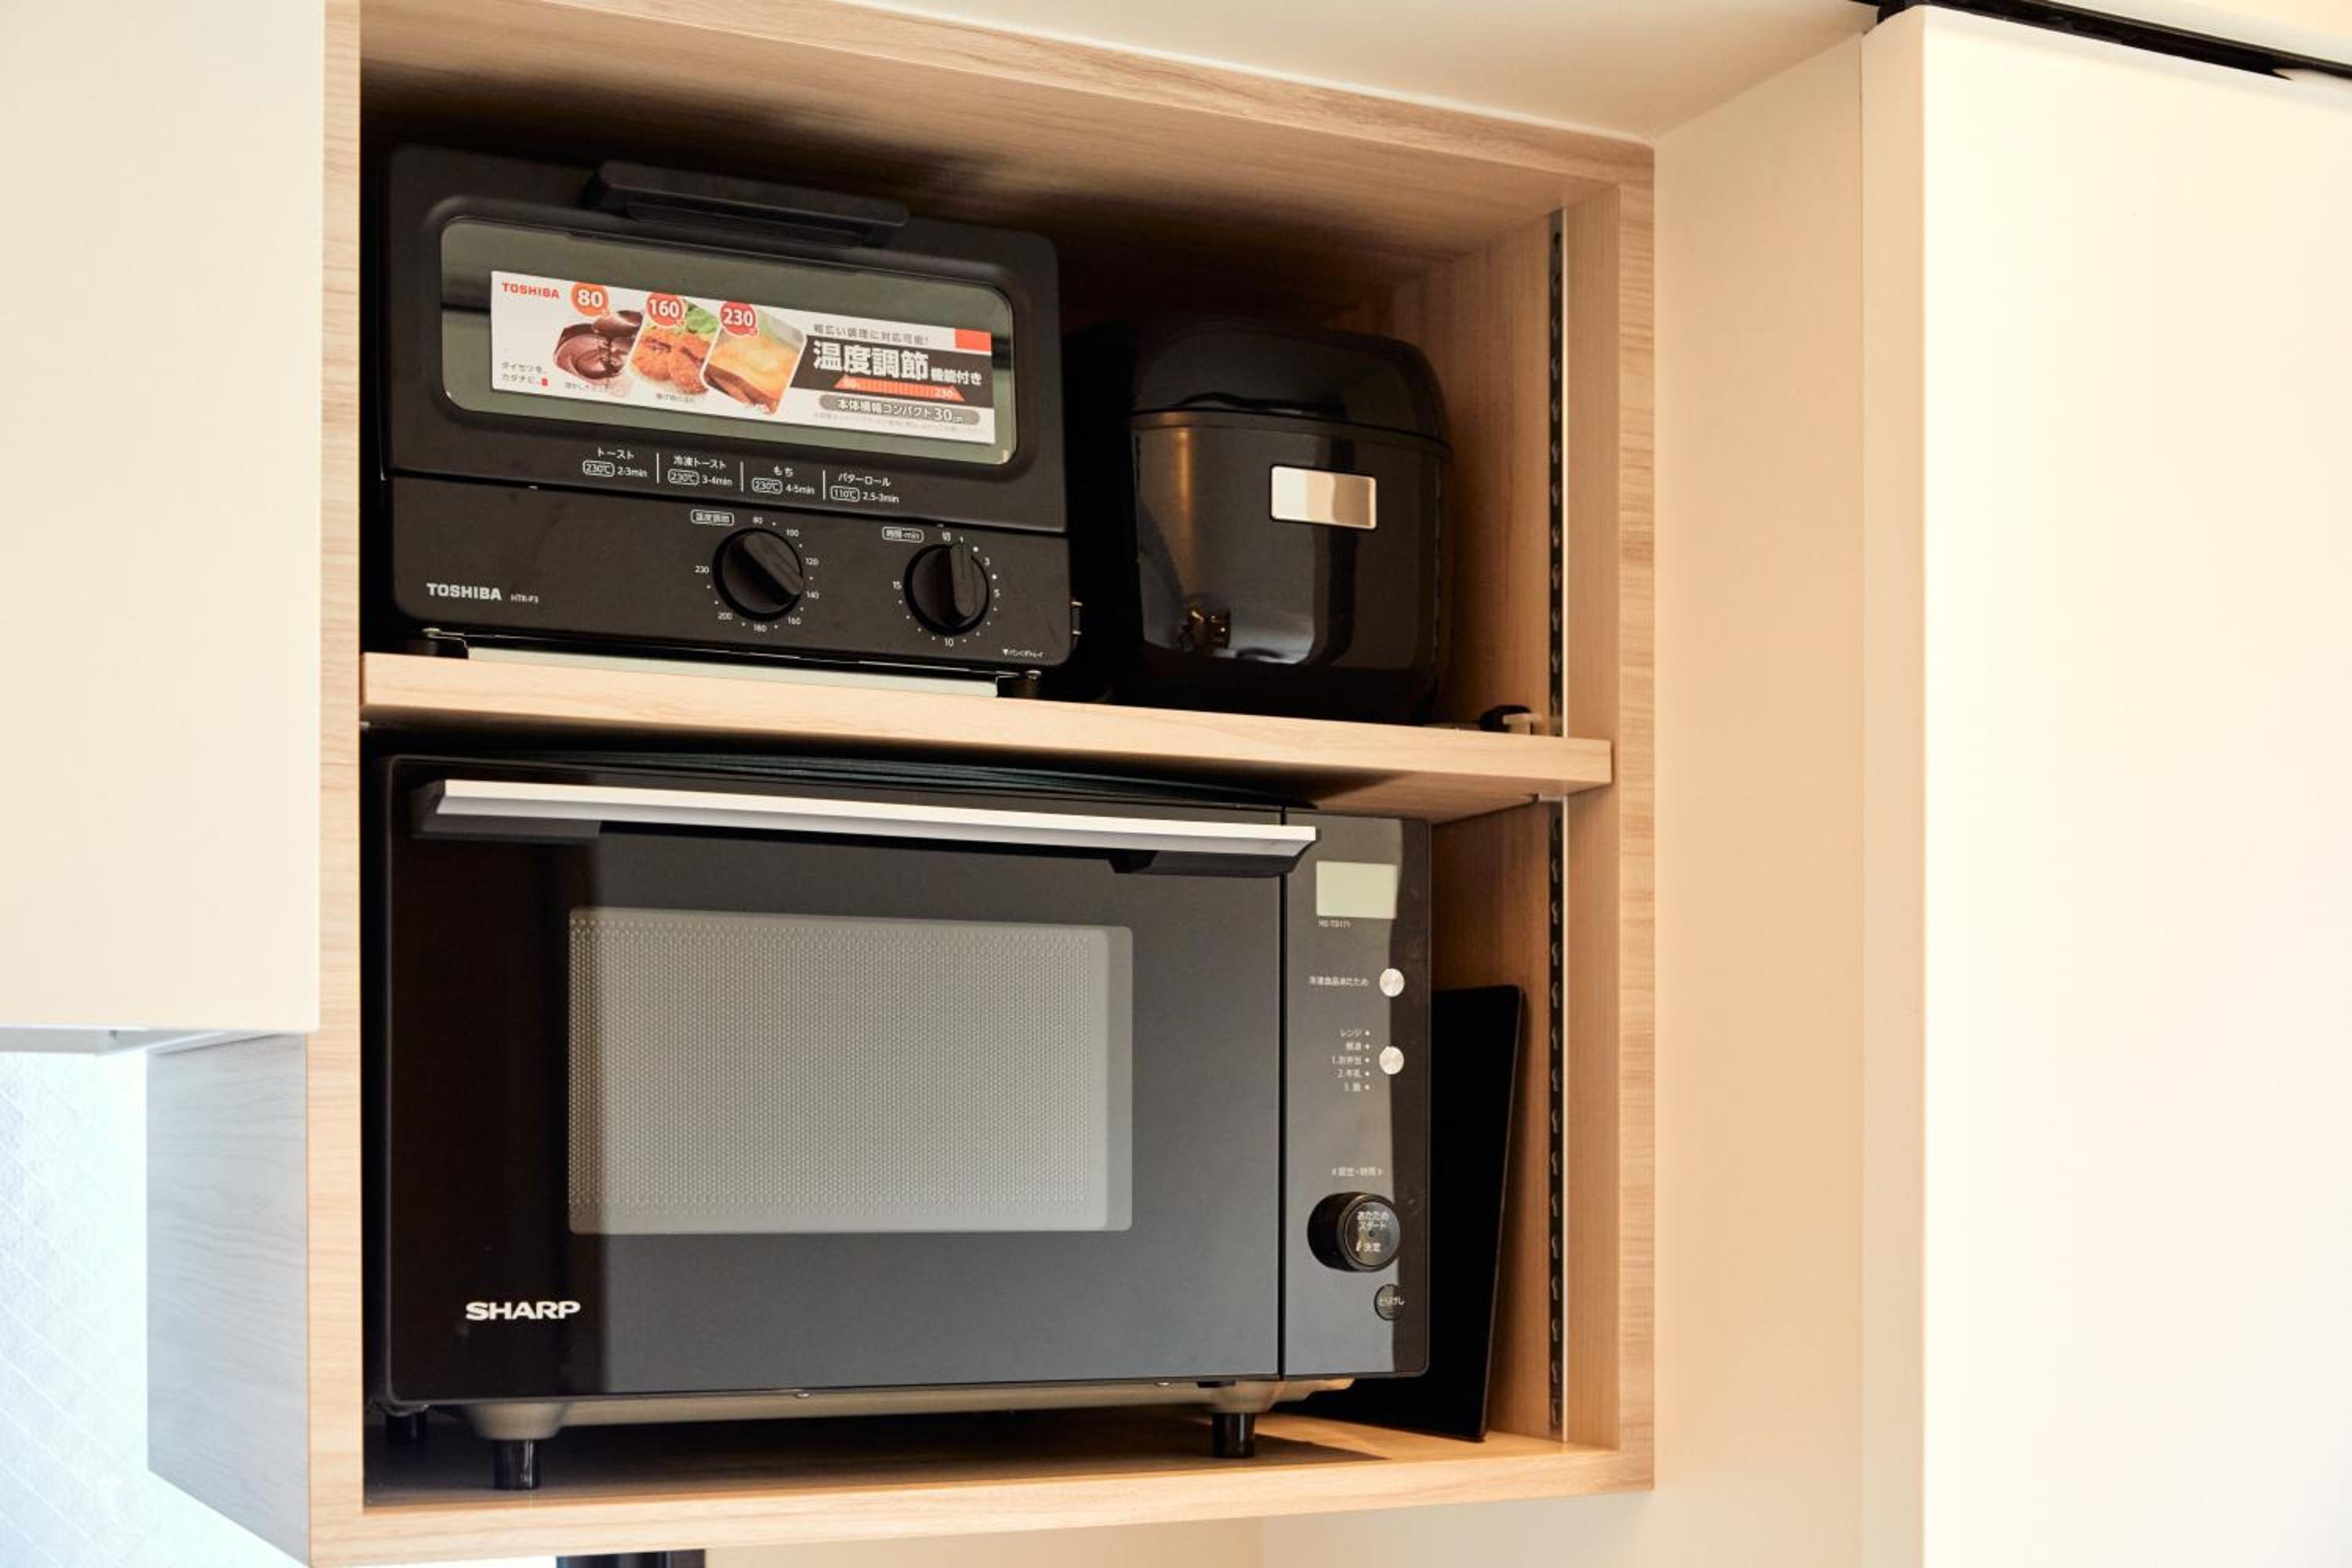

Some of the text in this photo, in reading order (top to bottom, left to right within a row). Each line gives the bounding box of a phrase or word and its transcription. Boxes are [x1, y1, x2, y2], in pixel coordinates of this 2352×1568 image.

[502, 282, 560, 299] TOSHIBA
[576, 289, 604, 308] 80
[649, 299, 680, 318] 160
[723, 308, 753, 326] 230
[597, 446, 634, 460] トースト
[673, 455, 728, 469] 冷凍トースト
[773, 465, 793, 477] もち
[838, 472, 891, 487] バターロール
[786, 529, 800, 538] 100
[805, 557, 820, 566] 120
[426, 582, 503, 601] TOSHIBA
[892, 581, 902, 590] 15
[806, 590, 820, 600] 140
[717, 612, 734, 621] 200
[944, 637, 954, 648] 10
[1356, 1210, 1390, 1221] あたため
[1359, 1220, 1387, 1230] スタート
[465, 1301, 581, 1321] SHARP
